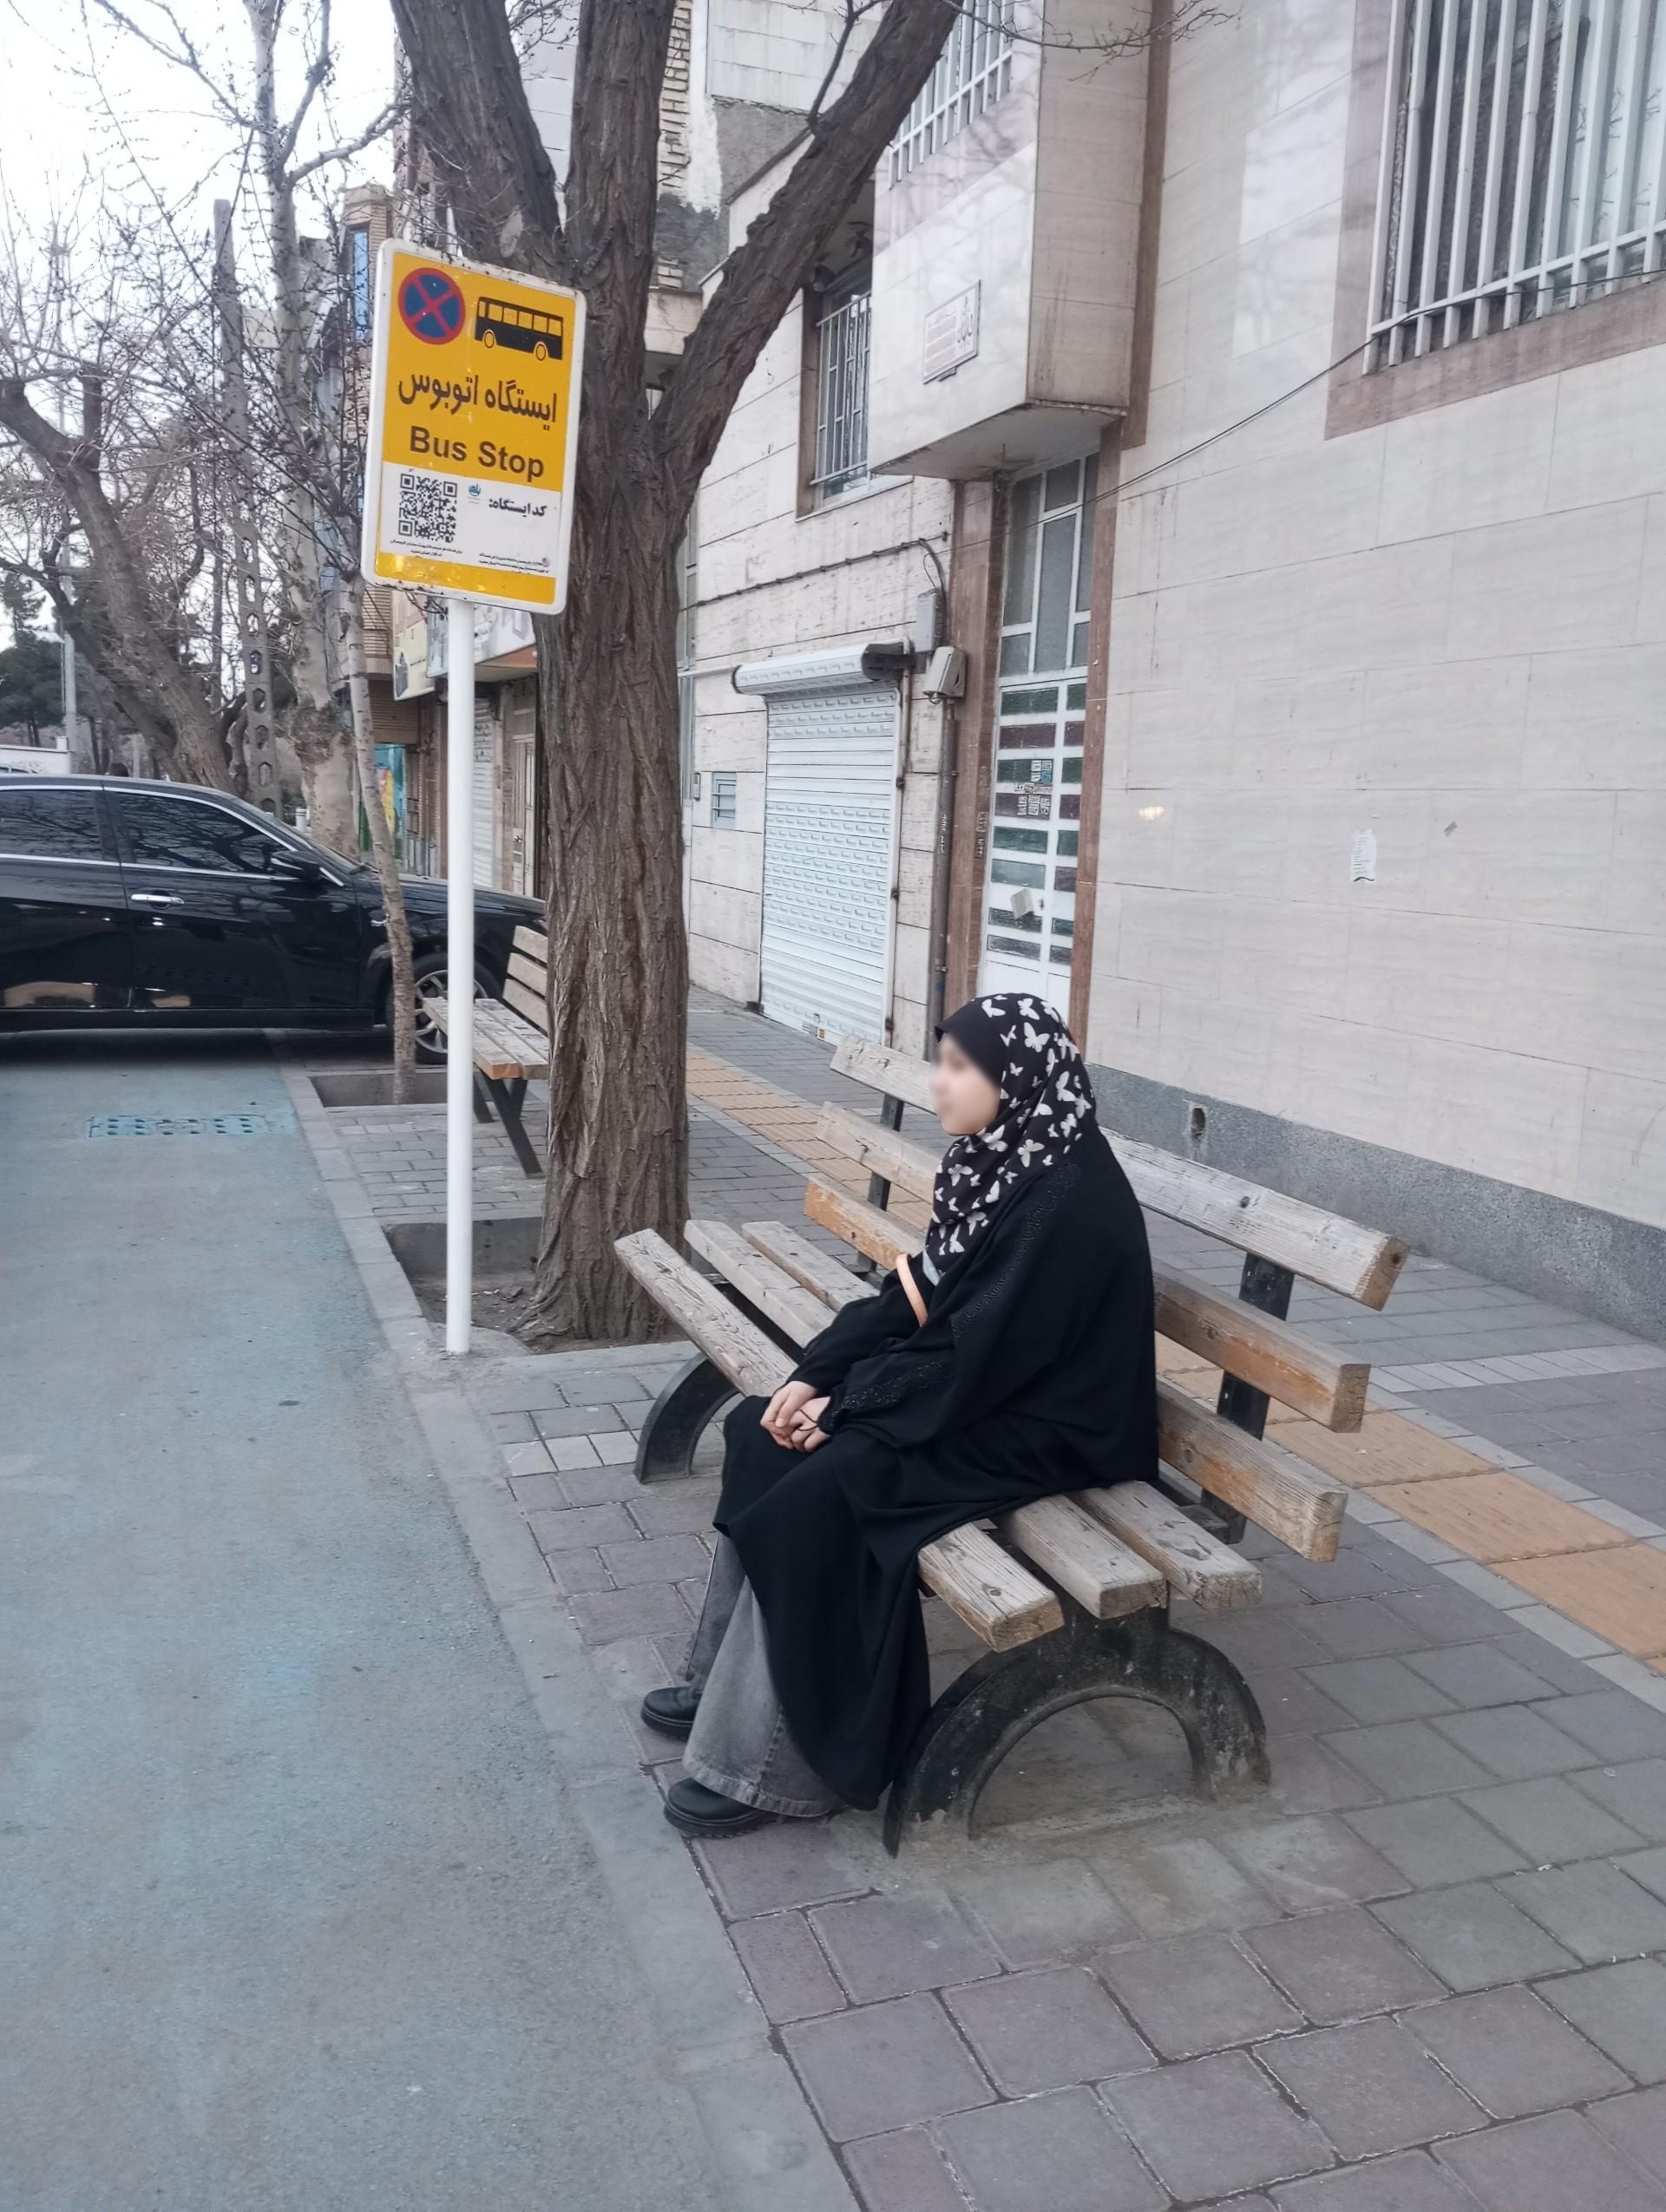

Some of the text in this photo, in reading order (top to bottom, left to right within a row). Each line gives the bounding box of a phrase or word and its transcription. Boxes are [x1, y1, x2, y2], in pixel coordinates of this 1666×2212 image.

[397, 374, 557, 430] ایستگاه اتوبوس
[410, 425, 544, 482] Bus Stop
[532, 505, 548, 517] کد
